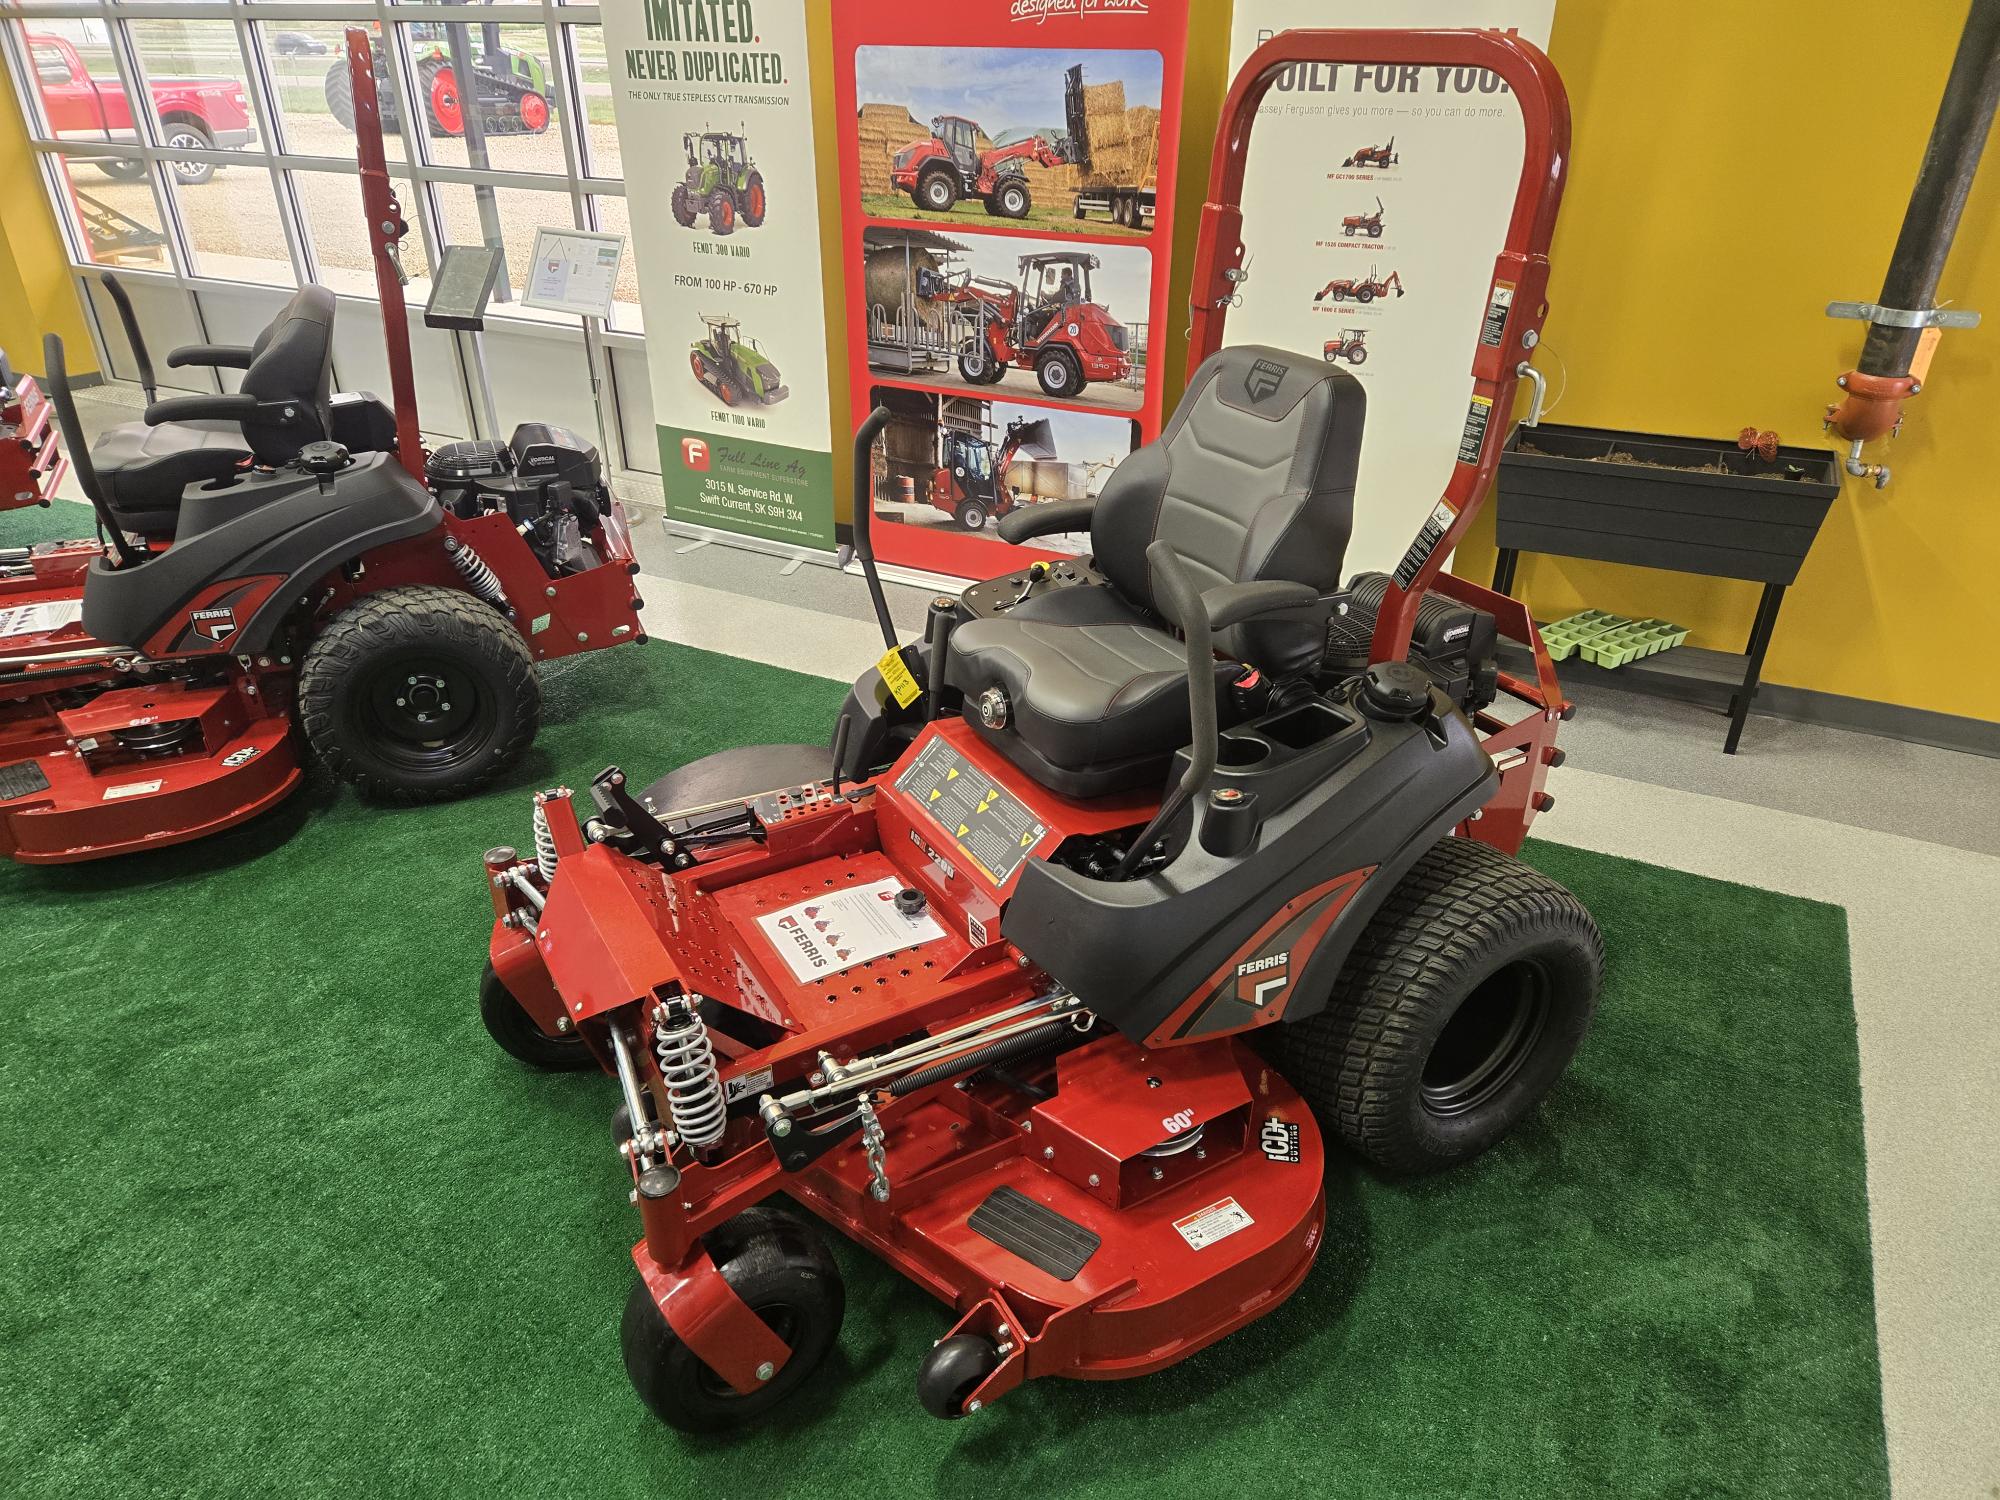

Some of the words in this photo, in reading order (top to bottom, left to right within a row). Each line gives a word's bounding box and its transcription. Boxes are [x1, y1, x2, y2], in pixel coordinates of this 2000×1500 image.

[643, 0, 760, 43] IMITATED.
[625, 49, 678, 81] NEVER
[682, 50, 788, 85] DUPLICATED.
[1354, 63, 1421, 93] FOR
[1436, 66, 1509, 94] YOU.
[628, 90, 642, 100] THE
[643, 92, 661, 100] ONLY
[663, 92, 681, 101] TRUE
[682, 93, 716, 103] STEPLESS
[718, 94, 733, 103] CVT
[734, 95, 790, 106] TRANSMISSION
[1258, 105, 1282, 116] assey
[1286, 104, 1324, 116] Ferguson
[1328, 104, 1350, 117] gives
[1353, 106, 1368, 117] you
[1370, 106, 1394, 116] more
[1411, 106, 1422, 116] so
[1425, 106, 1441, 118] you
[1444, 107, 1460, 116] can
[1464, 106, 1476, 117] do
[1479, 107, 1505, 118] more.
[730, 245, 750, 258] VARIO
[674, 274, 702, 288] FROM
[705, 278, 720, 290] 100
[723, 280, 736, 291] HP
[744, 282, 761, 294] 670
[764, 285, 778, 296] HP
[1256, 361, 1286, 375] FERRIS
[711, 410, 729, 423] FENDT
[747, 416, 766, 428] VARIO
[717, 447, 746, 464] Full
[750, 453, 780, 470] Line
[705, 478, 726, 492] 3015
[728, 482, 736, 494] N.
[738, 484, 768, 499] Service
[770, 490, 783, 502] Rd.
[784, 493, 794, 505] W.
[700, 492, 720, 506] Swift
[721, 496, 753, 513] Current,
[754, 502, 767, 515] SK
[768, 505, 785, 518] S9H
[786, 509, 803, 522] 3X4
[193, 610, 230, 620] FERRIS
[790, 927, 827, 968] FERRIS
[1238, 952, 1288, 976] FERRIS
[1162, 1108, 1195, 1134] 60"
[1290, 1124, 1299, 1162] CUTTING
